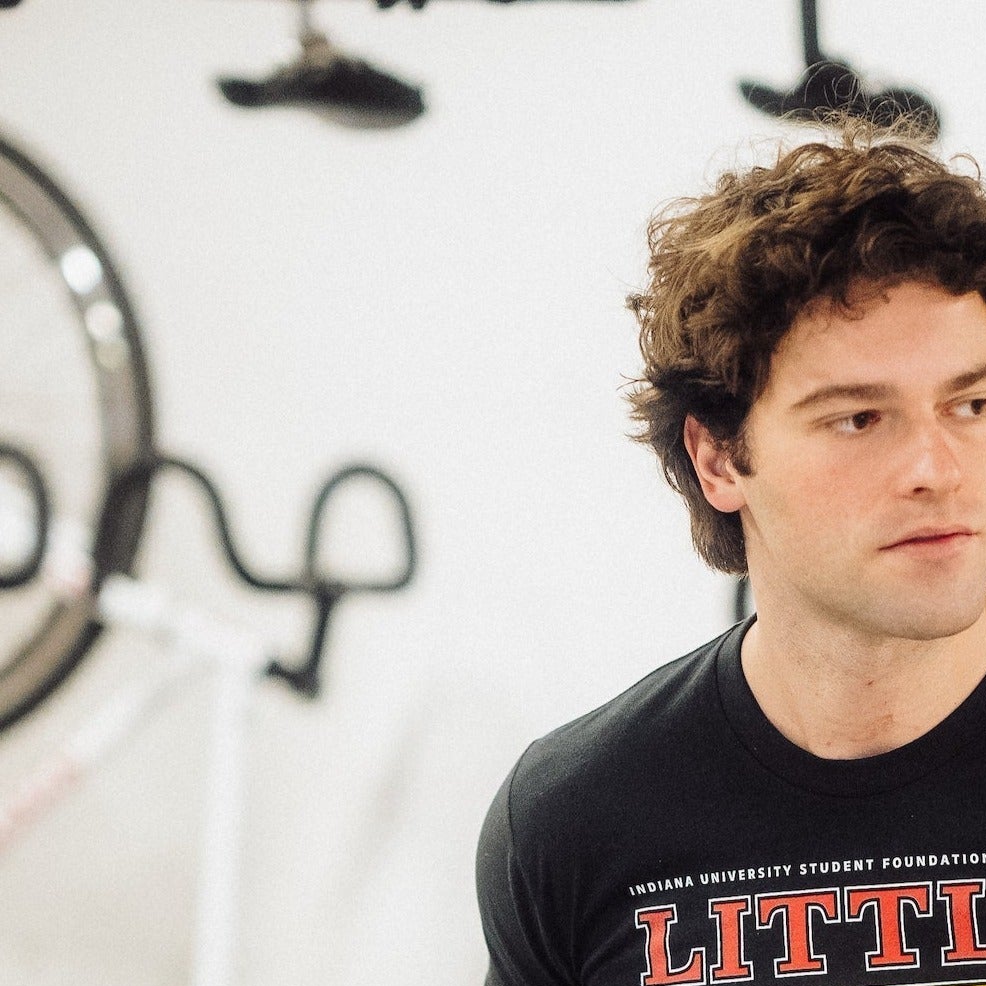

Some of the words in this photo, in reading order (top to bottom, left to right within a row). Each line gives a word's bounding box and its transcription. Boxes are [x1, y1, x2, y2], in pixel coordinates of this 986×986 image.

[629, 875, 694, 896] INDIANA
[700, 864, 792, 885] UNIVERSITY
[799, 858, 874, 875] STUDENT
